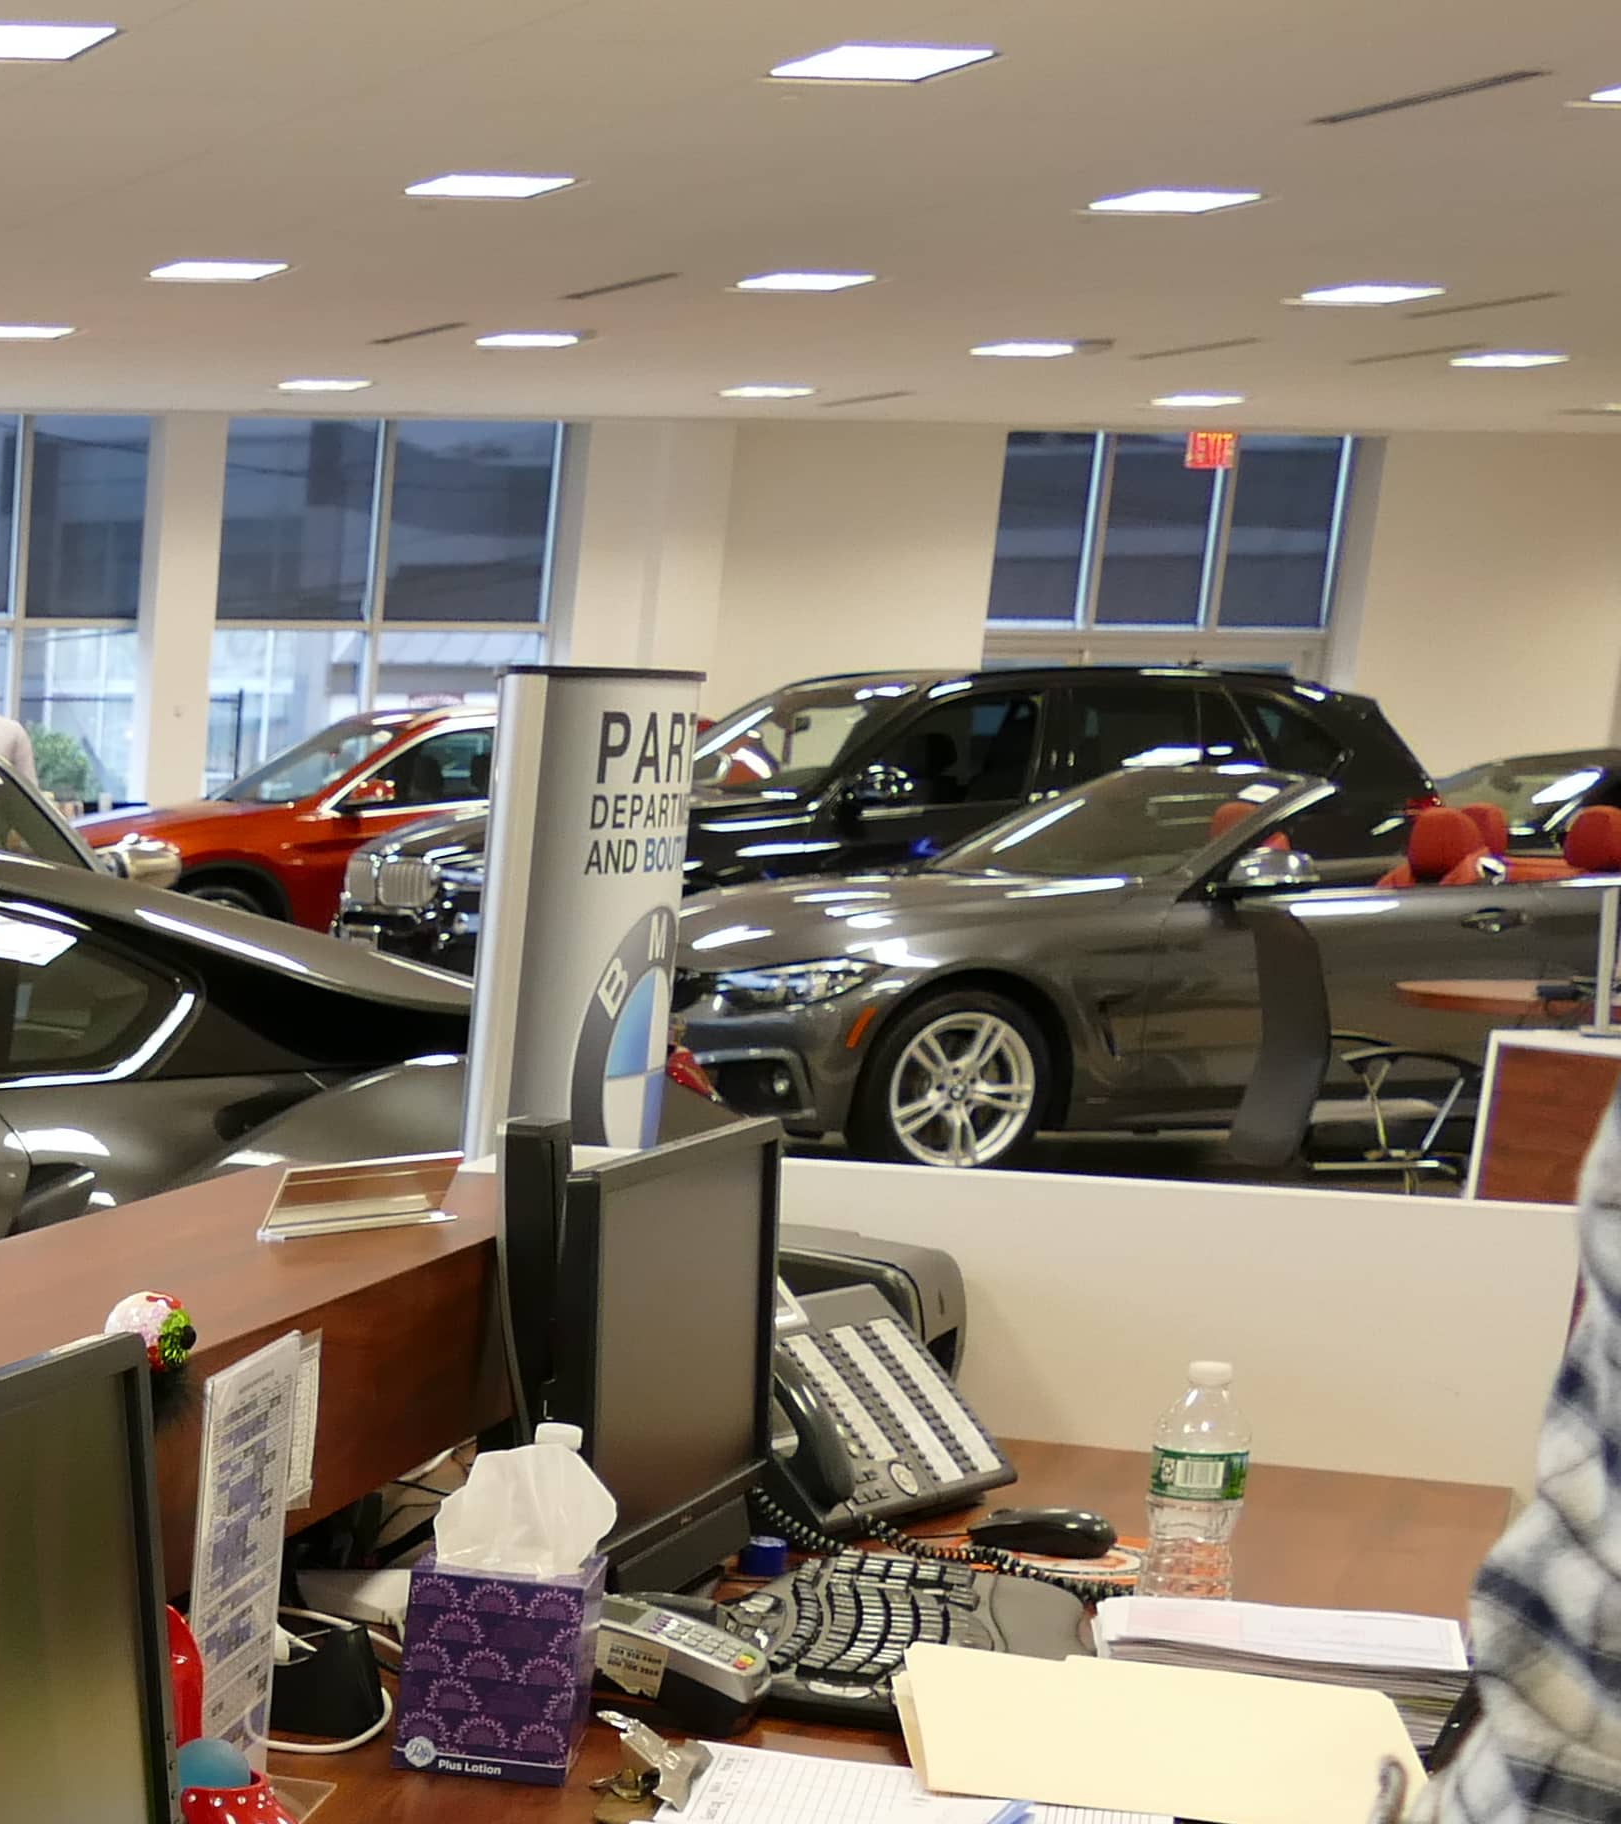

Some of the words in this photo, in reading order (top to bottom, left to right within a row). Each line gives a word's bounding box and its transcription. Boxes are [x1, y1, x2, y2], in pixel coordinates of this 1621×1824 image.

[584, 839, 639, 876] AND
[438, 1758, 463, 1772] Plus
[464, 1762, 502, 1775] Lotion
